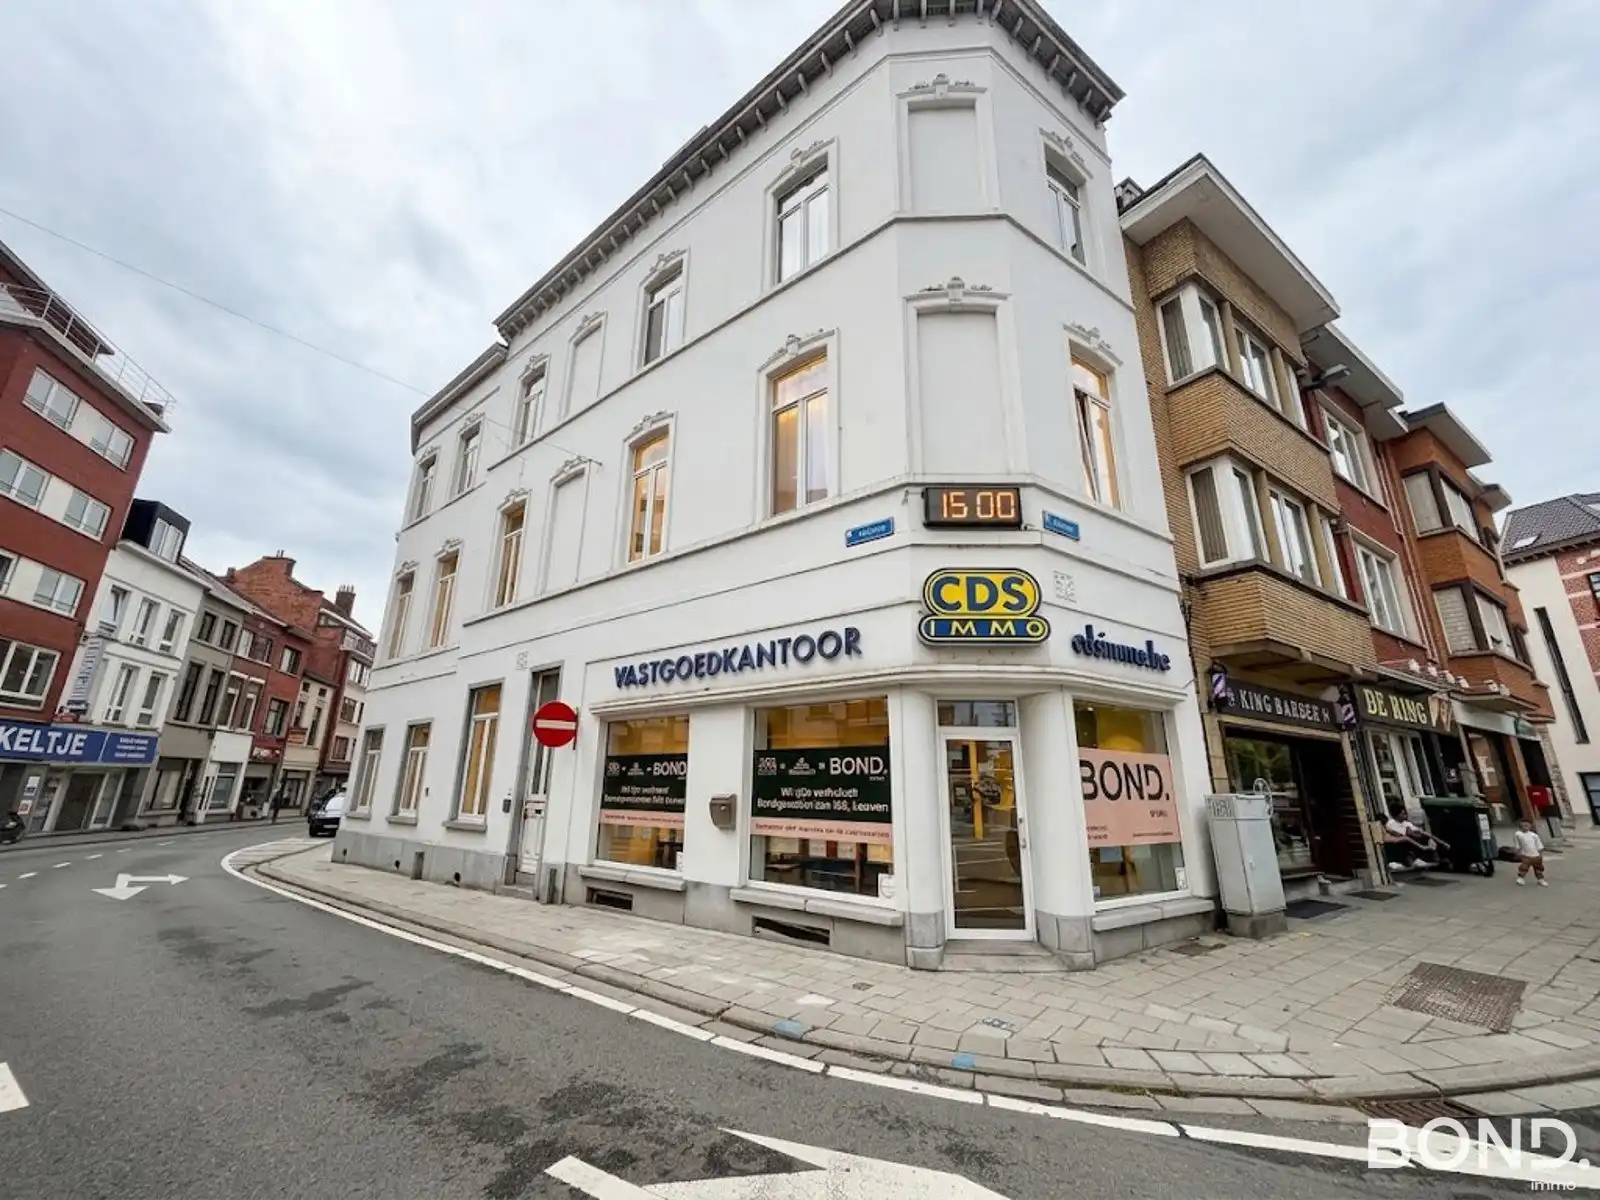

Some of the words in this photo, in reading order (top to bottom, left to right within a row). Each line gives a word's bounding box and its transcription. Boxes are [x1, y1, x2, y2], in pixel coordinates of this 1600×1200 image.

[932, 576, 1028, 612] CDS
[930, 620, 1044, 637] IMMO
[614, 627, 862, 688] VASTGOEDKANTOOR
[1239, 689, 1272, 713] KING
[1363, 688, 1388, 717] DE
[829, 757, 889, 775] BOND.
[1079, 760, 1170, 801] BOND.
